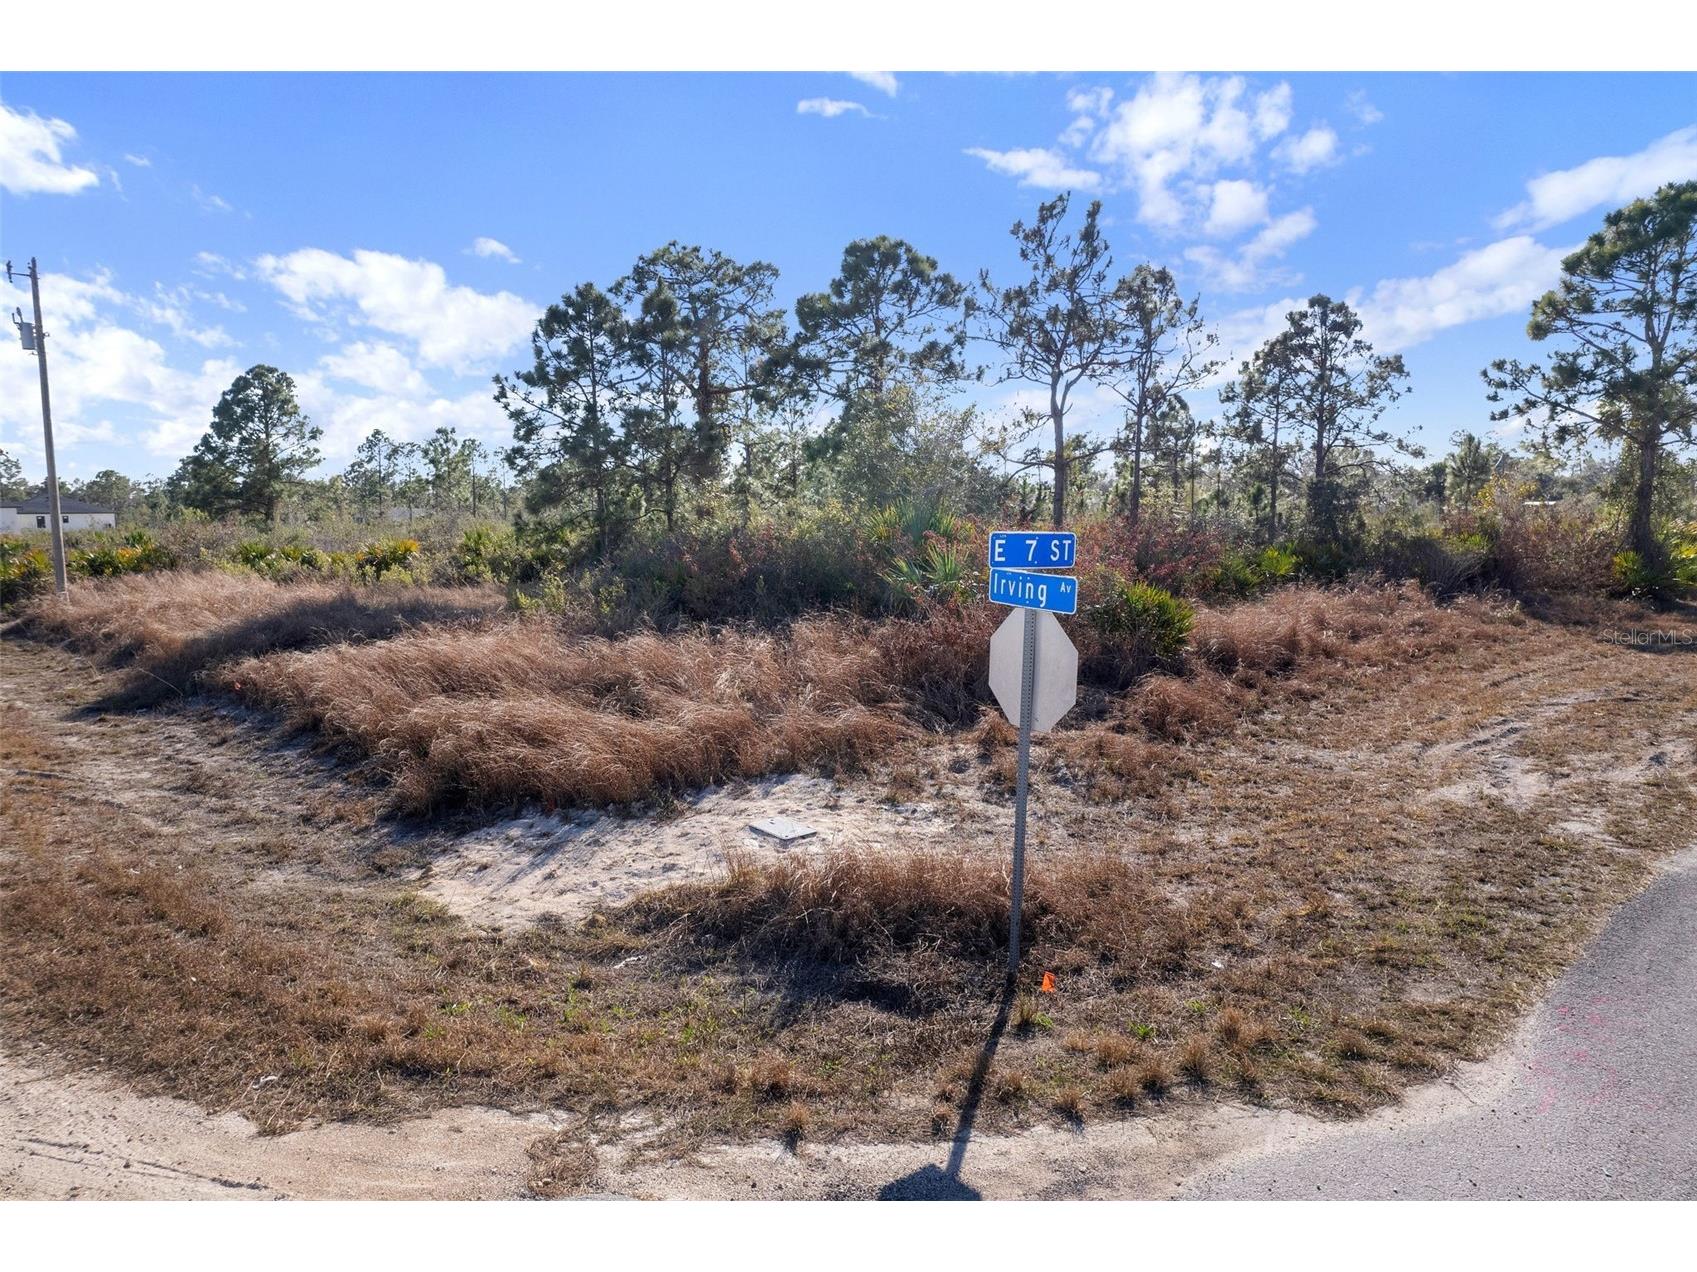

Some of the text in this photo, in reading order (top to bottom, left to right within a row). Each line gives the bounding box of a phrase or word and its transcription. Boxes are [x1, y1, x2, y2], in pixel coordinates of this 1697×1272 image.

[994, 539, 1072, 562] E 7 ST
[994, 572, 1072, 608] Irving Av
